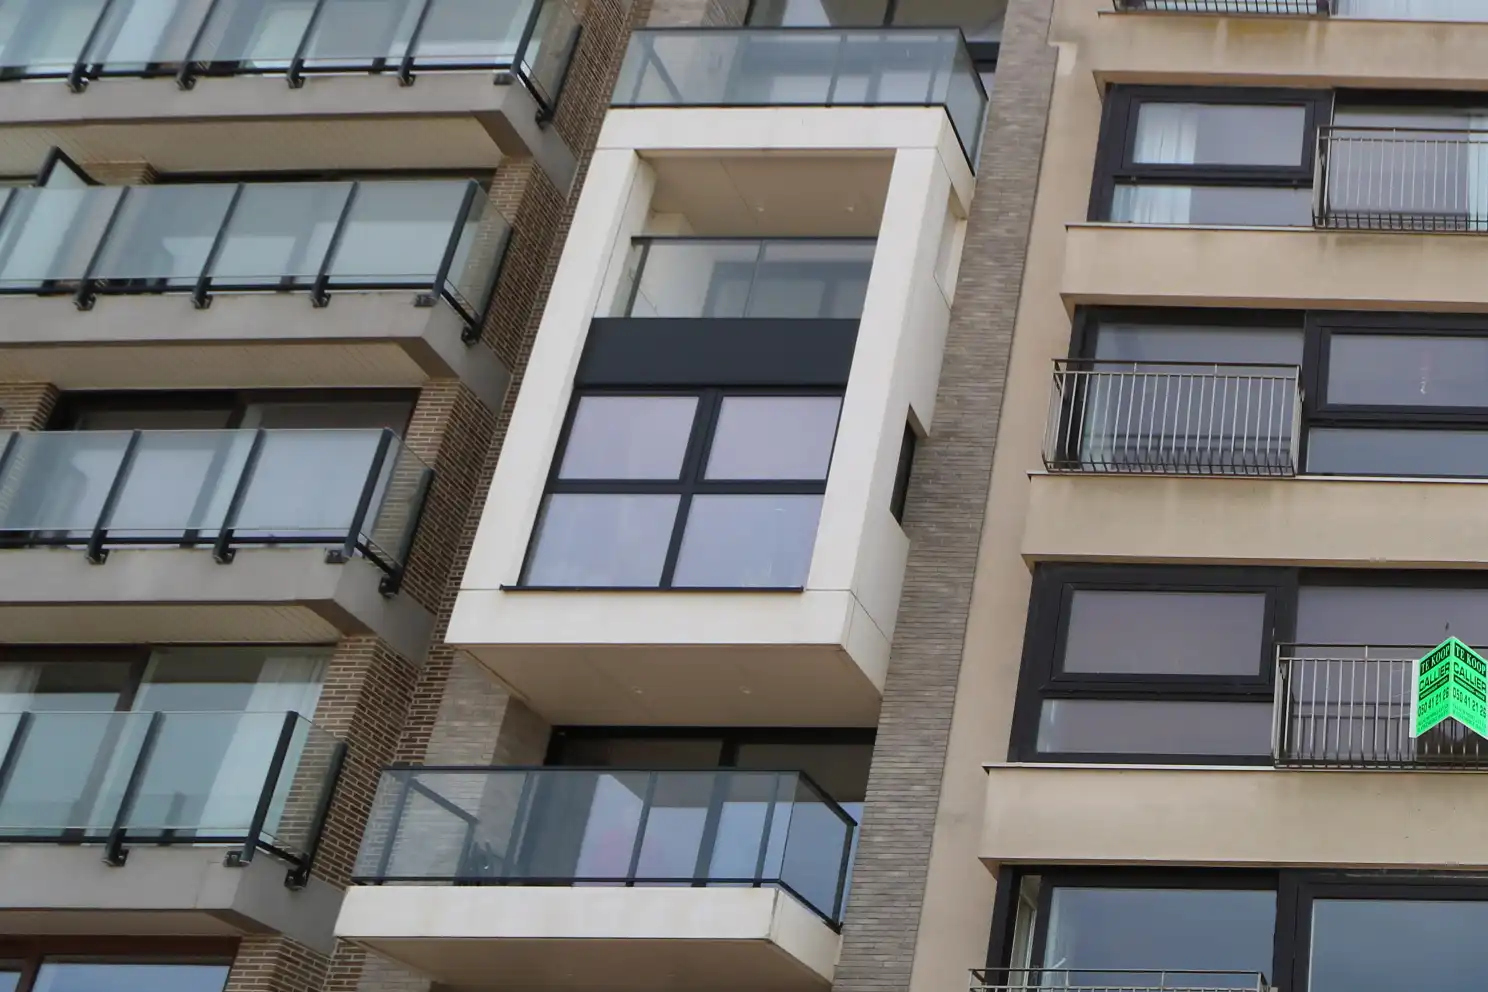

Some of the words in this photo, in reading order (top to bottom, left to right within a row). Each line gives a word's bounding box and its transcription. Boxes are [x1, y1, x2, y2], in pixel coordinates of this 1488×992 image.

[1421, 661, 1430, 674] TE
[1431, 645, 1450, 668] KOOP
[1455, 643, 1465, 659] TE
[1466, 652, 1486, 676] KOOP
[1420, 662, 1450, 691] CALLIER
[1453, 661, 1487, 693] CALLIER
[1418, 702, 1428, 717] 050
[1428, 696, 1435, 709] 41
[1453, 687, 1463, 702] 050
[1464, 695, 1471, 709] 41
[1472, 699, 1479, 713] 21
